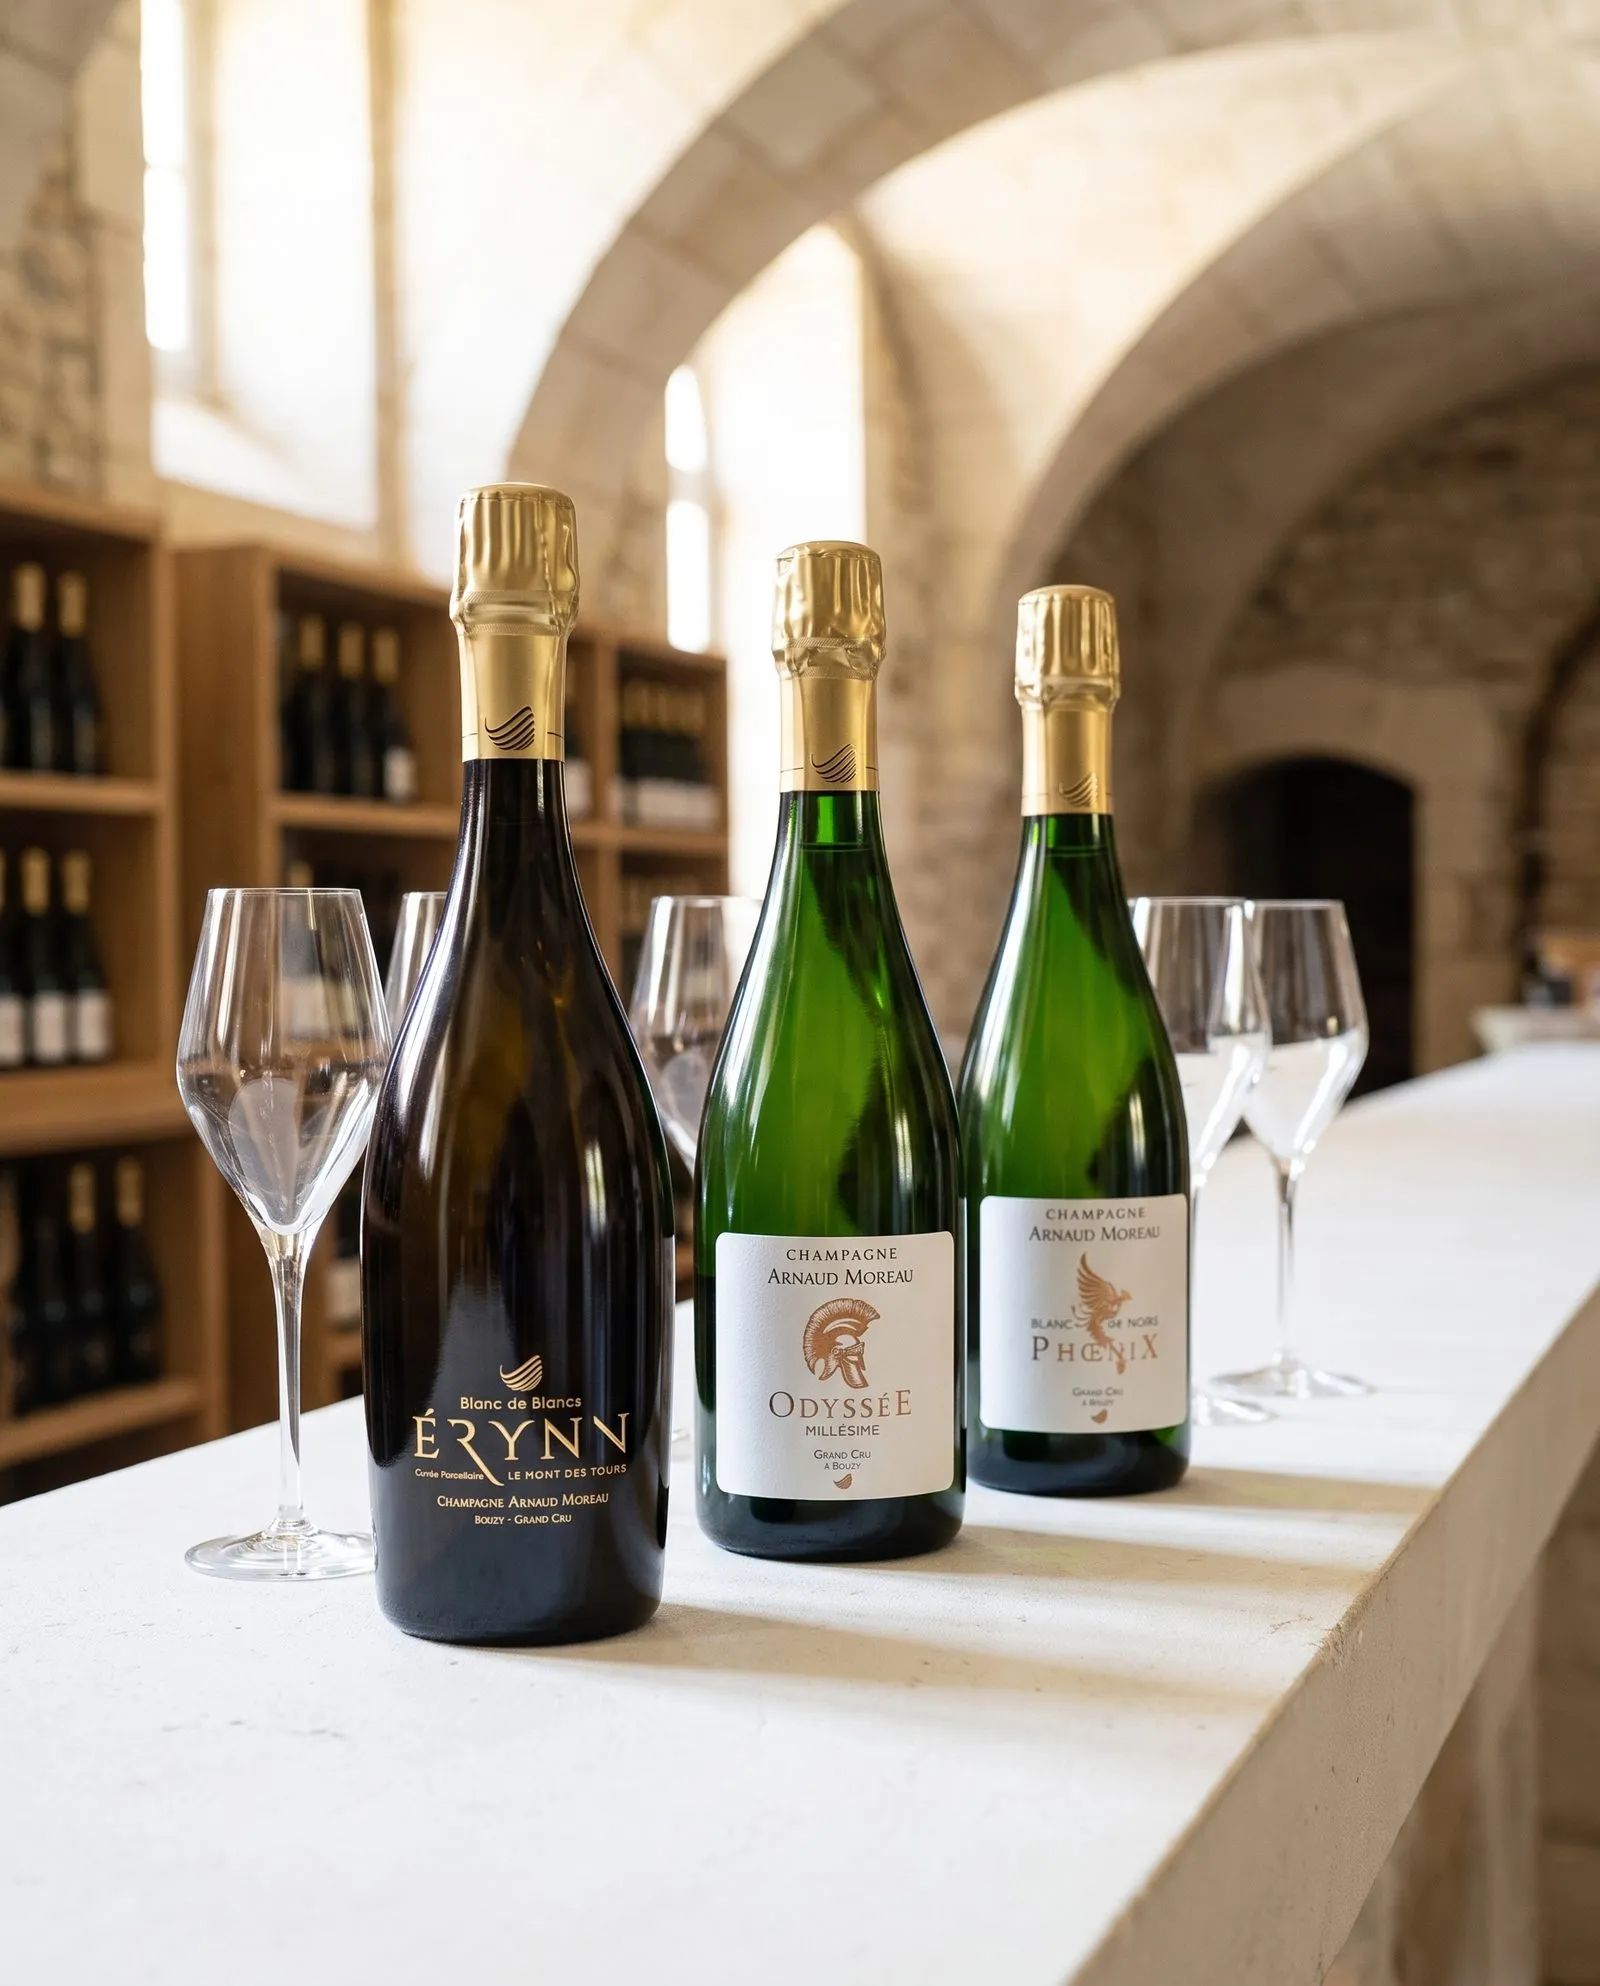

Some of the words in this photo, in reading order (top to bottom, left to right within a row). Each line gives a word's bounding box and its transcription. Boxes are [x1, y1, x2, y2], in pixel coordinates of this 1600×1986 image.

[1046, 1207, 1146, 1220] CHAMPAGNE
[1029, 1226, 1095, 1242] ARNAUD
[1101, 1226, 1160, 1241] MOREAU
[787, 1248, 898, 1261] CHAMPAGNE
[768, 1268, 838, 1286] ARNAUD
[845, 1269, 914, 1284] MOREAU
[1031, 1318, 1073, 1329] BLANC
[1127, 1316, 1159, 1328] NOIRS
[460, 1397, 502, 1410] Blanc
[507, 1396, 526, 1410] de
[532, 1396, 582, 1410] Blancs
[769, 1389, 912, 1418] ODYSSÉE
[806, 1423, 880, 1437] MILLÉSIME
[412, 1407, 630, 1486] ÉRYNN
[814, 1449, 848, 1460] GRAND
[851, 1449, 871, 1459] CRU
[415, 1469, 439, 1479] Cuvée
[508, 1472, 520, 1480] LE
[525, 1470, 560, 1480] MONT
[565, 1468, 587, 1479] DES
[590, 1464, 627, 1477] TOURS
[832, 1462, 861, 1470] BOUZY
[437, 1495, 504, 1508] CHAMPAGNE
[508, 1496, 558, 1508] ARNAUD
[562, 1493, 609, 1506] MOREAU
[474, 1515, 504, 1525] BOUZY
[514, 1515, 549, 1525] GRAND
[552, 1513, 572, 1524] CRU
